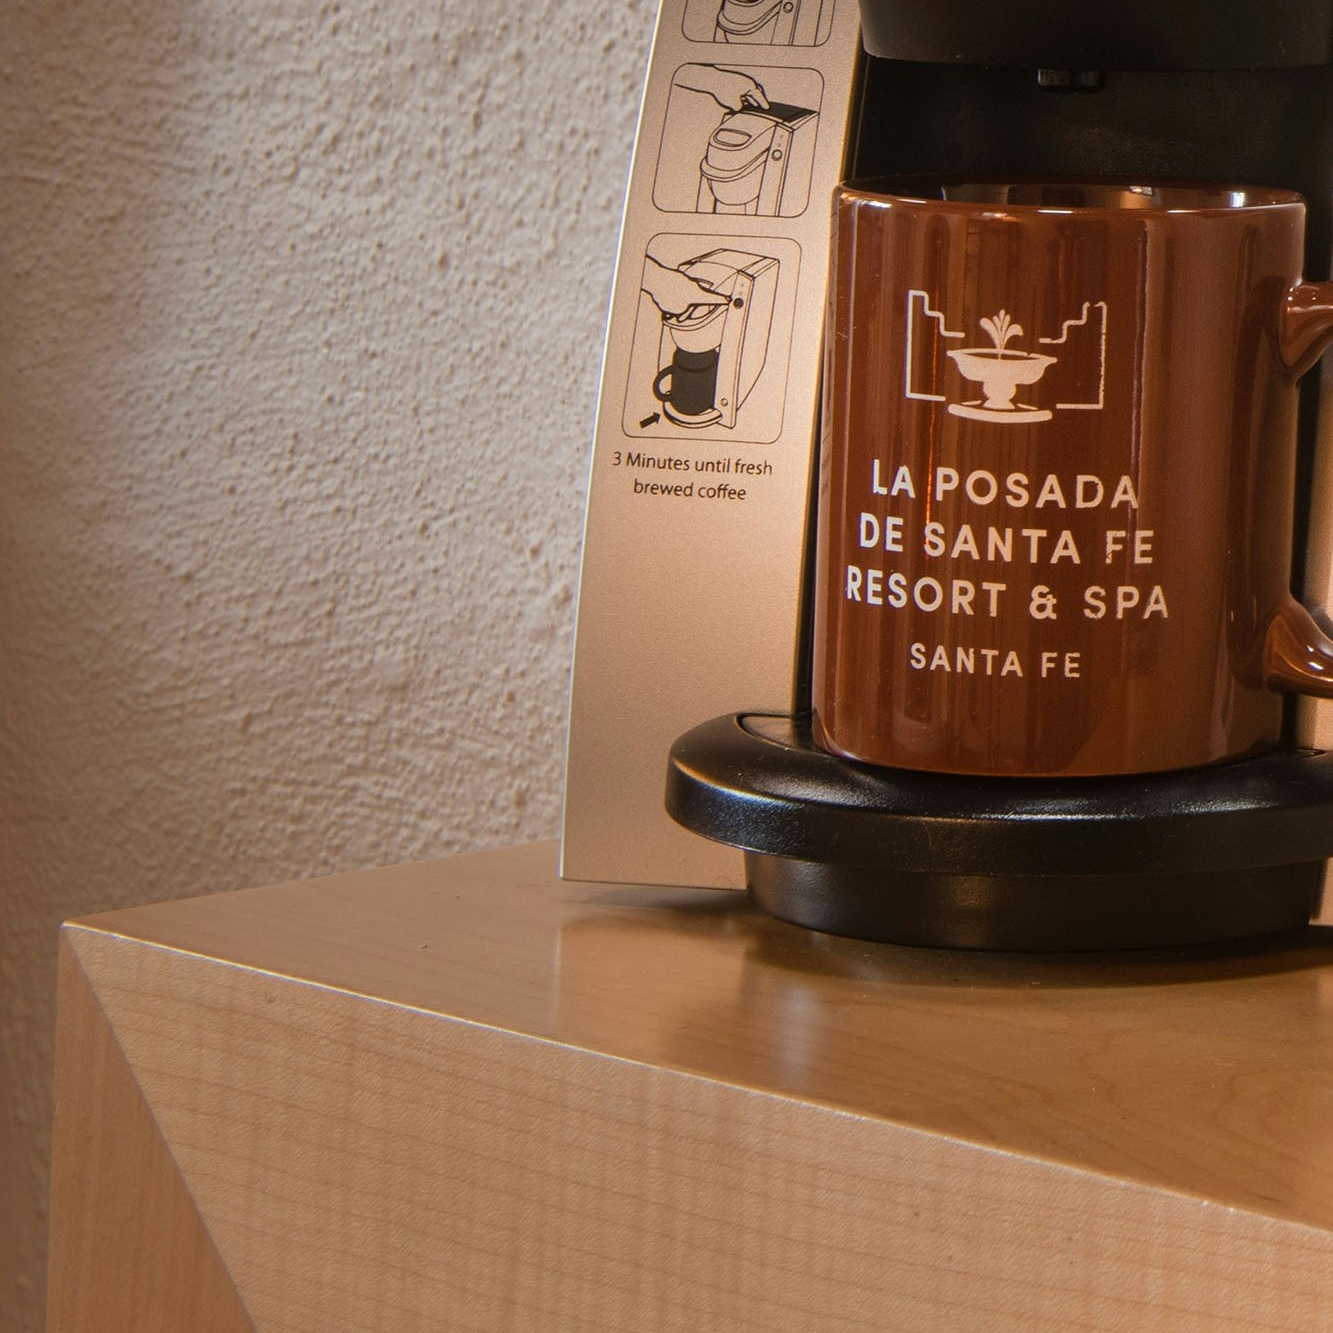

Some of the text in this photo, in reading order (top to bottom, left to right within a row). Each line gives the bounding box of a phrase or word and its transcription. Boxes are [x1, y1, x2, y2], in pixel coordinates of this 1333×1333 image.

[612, 451, 773, 476] 3 Minutes until fresh
[872, 459, 1140, 509] LA POSADA
[633, 478, 747, 500] brewed coffee
[859, 512, 1155, 565] DE SANTA FE
[846, 564, 1169, 620] RESORT & SPA
[910, 642, 1082, 678] SANTA FE
